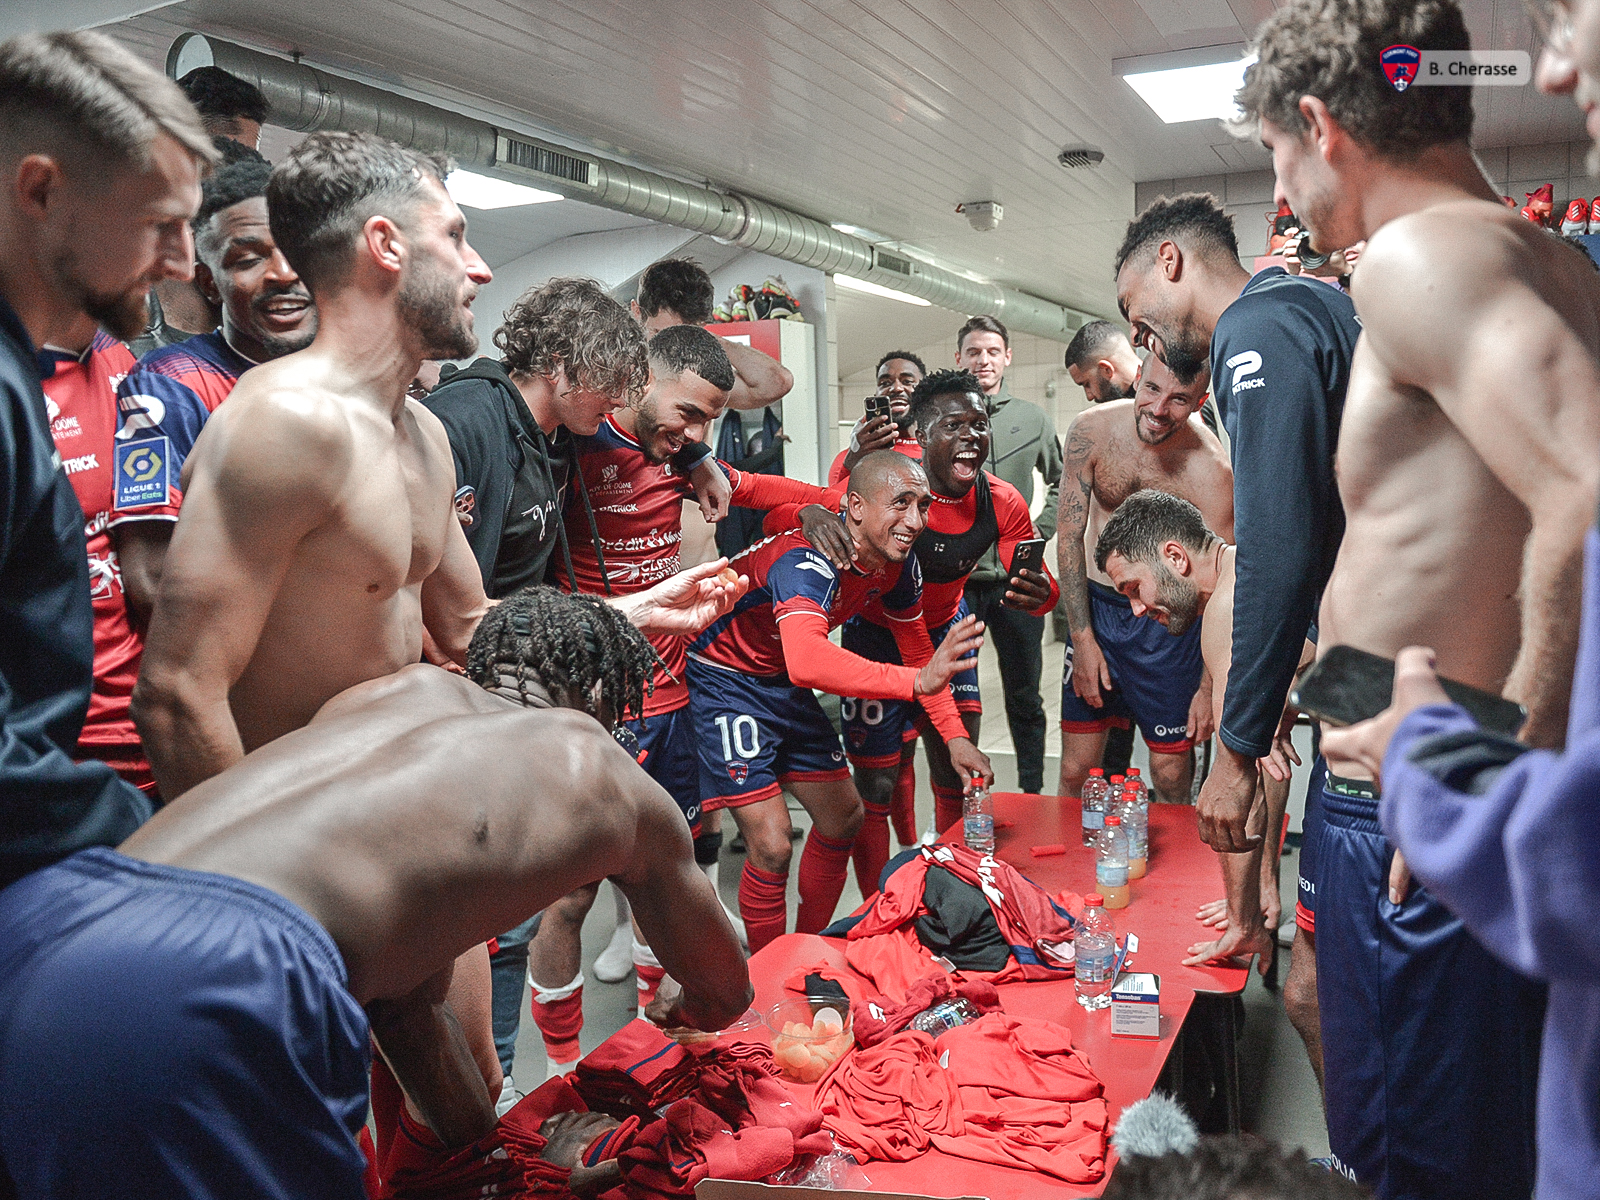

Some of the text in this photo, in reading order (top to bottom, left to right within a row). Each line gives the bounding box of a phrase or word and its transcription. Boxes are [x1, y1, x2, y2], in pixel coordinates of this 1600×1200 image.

[62, 454, 100, 475] TRICK
[120, 491, 163, 503] Uber Eats
[123, 483, 155, 494] LIGUE
[714, 714, 761, 762] 10
[1331, 1152, 1358, 1186] OLIA
